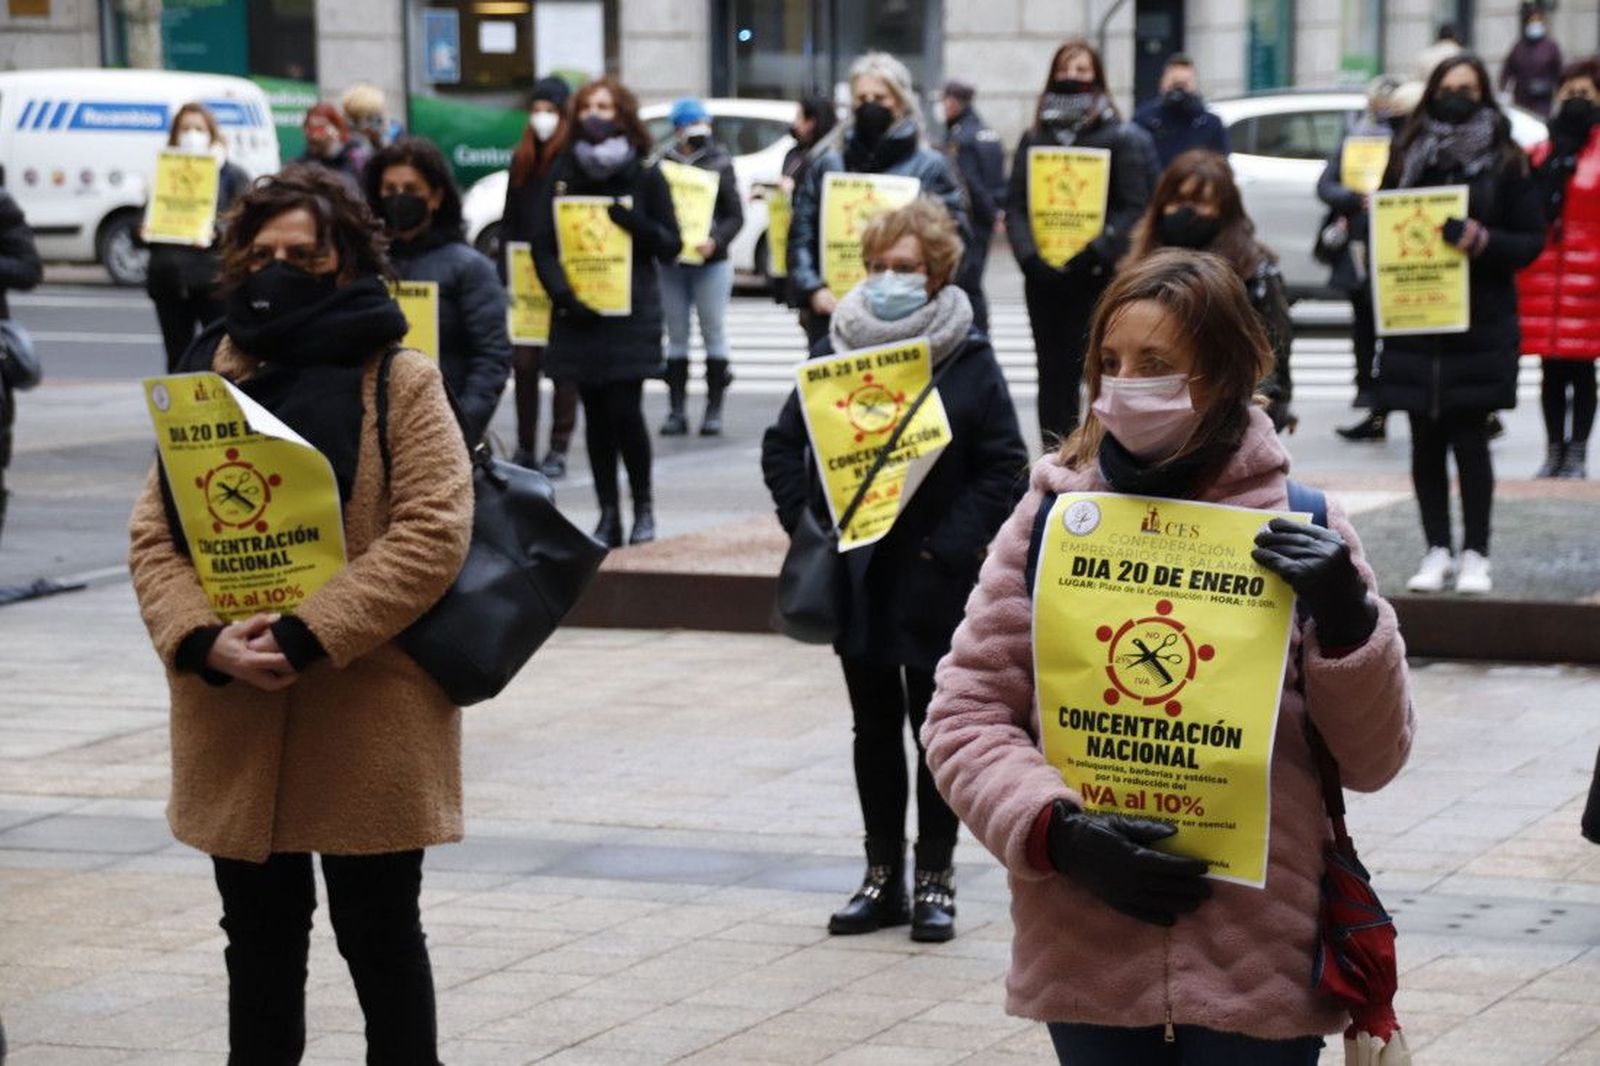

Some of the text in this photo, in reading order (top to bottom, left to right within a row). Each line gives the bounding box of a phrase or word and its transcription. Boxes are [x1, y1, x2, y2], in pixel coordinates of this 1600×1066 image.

[877, 348, 921, 367] ENERO
[190, 424, 212, 442] 20
[216, 421, 240, 438] DE
[211, 551, 293, 573] NACIONAL
[1071, 556, 1265, 597] DIA 20 DE ENERO
[262, 583, 305, 603] 10%
[1058, 578, 1097, 590] LUGAR:
[1210, 595, 1244, 606] HORA:
[1058, 705, 1243, 750] CONCENTRACIÓN
[1086, 735, 1200, 770] NACIONAL
[1095, 773, 1111, 783] por
[1171, 782, 1187, 791] del
[1080, 783, 1118, 808] IVA
[1124, 790, 1146, 810] al
[1153, 793, 1205, 817] 10%
